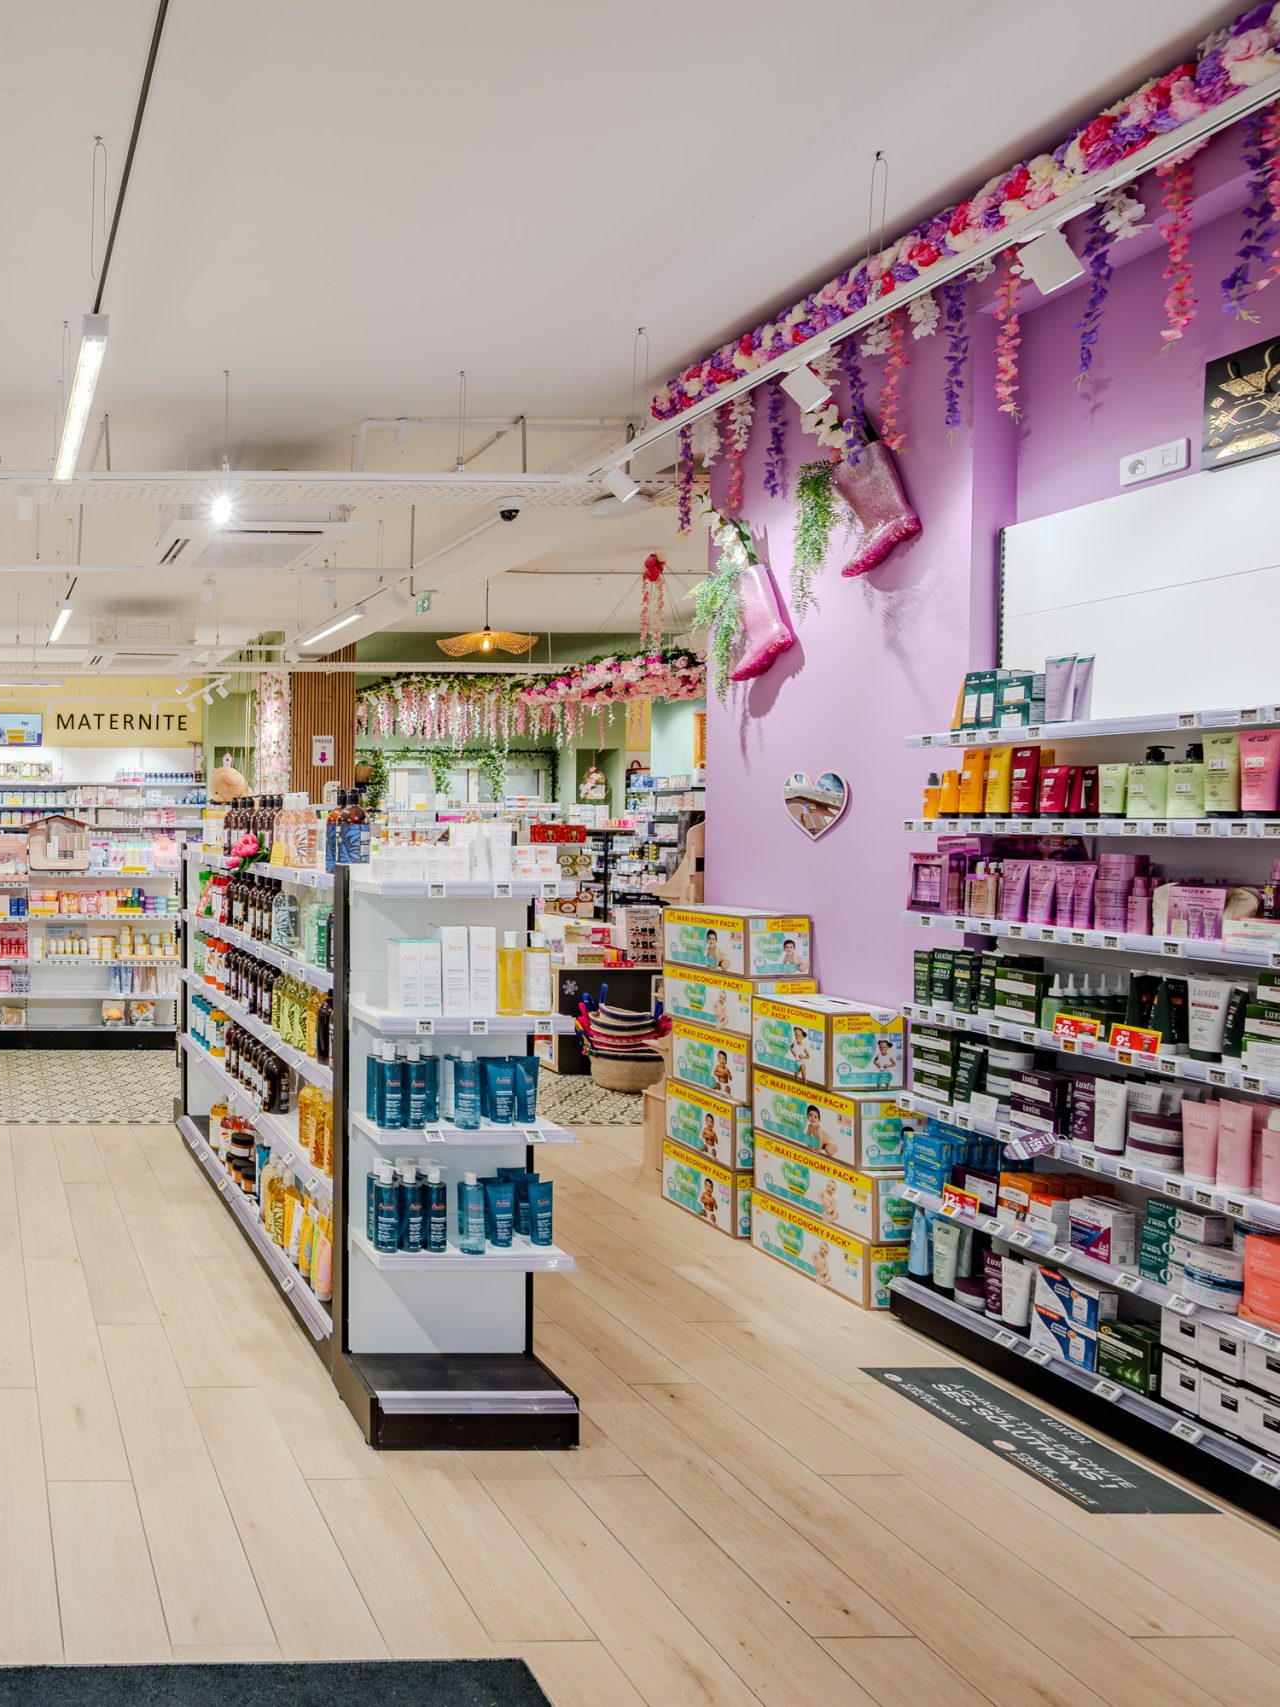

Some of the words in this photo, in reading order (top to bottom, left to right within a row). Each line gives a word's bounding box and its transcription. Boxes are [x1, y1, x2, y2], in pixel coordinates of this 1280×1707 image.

[56, 713, 188, 731] MATERNITE
[771, 1004, 786, 1014] MAXI
[787, 1008, 817, 1021] ECONOMY
[770, 1079, 786, 1090] MAXI
[787, 1084, 823, 1102] ECONOMY
[775, 1146, 792, 1158] MAXI
[793, 1153, 831, 1174] ECONOMY
[770, 1205, 787, 1218] MAXI
[788, 1212, 824, 1236] ECONOMY
[932, 1383, 977, 1407] SES
[973, 1407, 1104, 1481] SOLUTIONS
[963, 1390, 1020, 1422] CHAQUE
[1018, 1421, 1057, 1444] TYPE
[1055, 1443, 1081, 1458] DE
[1079, 1456, 1138, 1490] CHUTE
